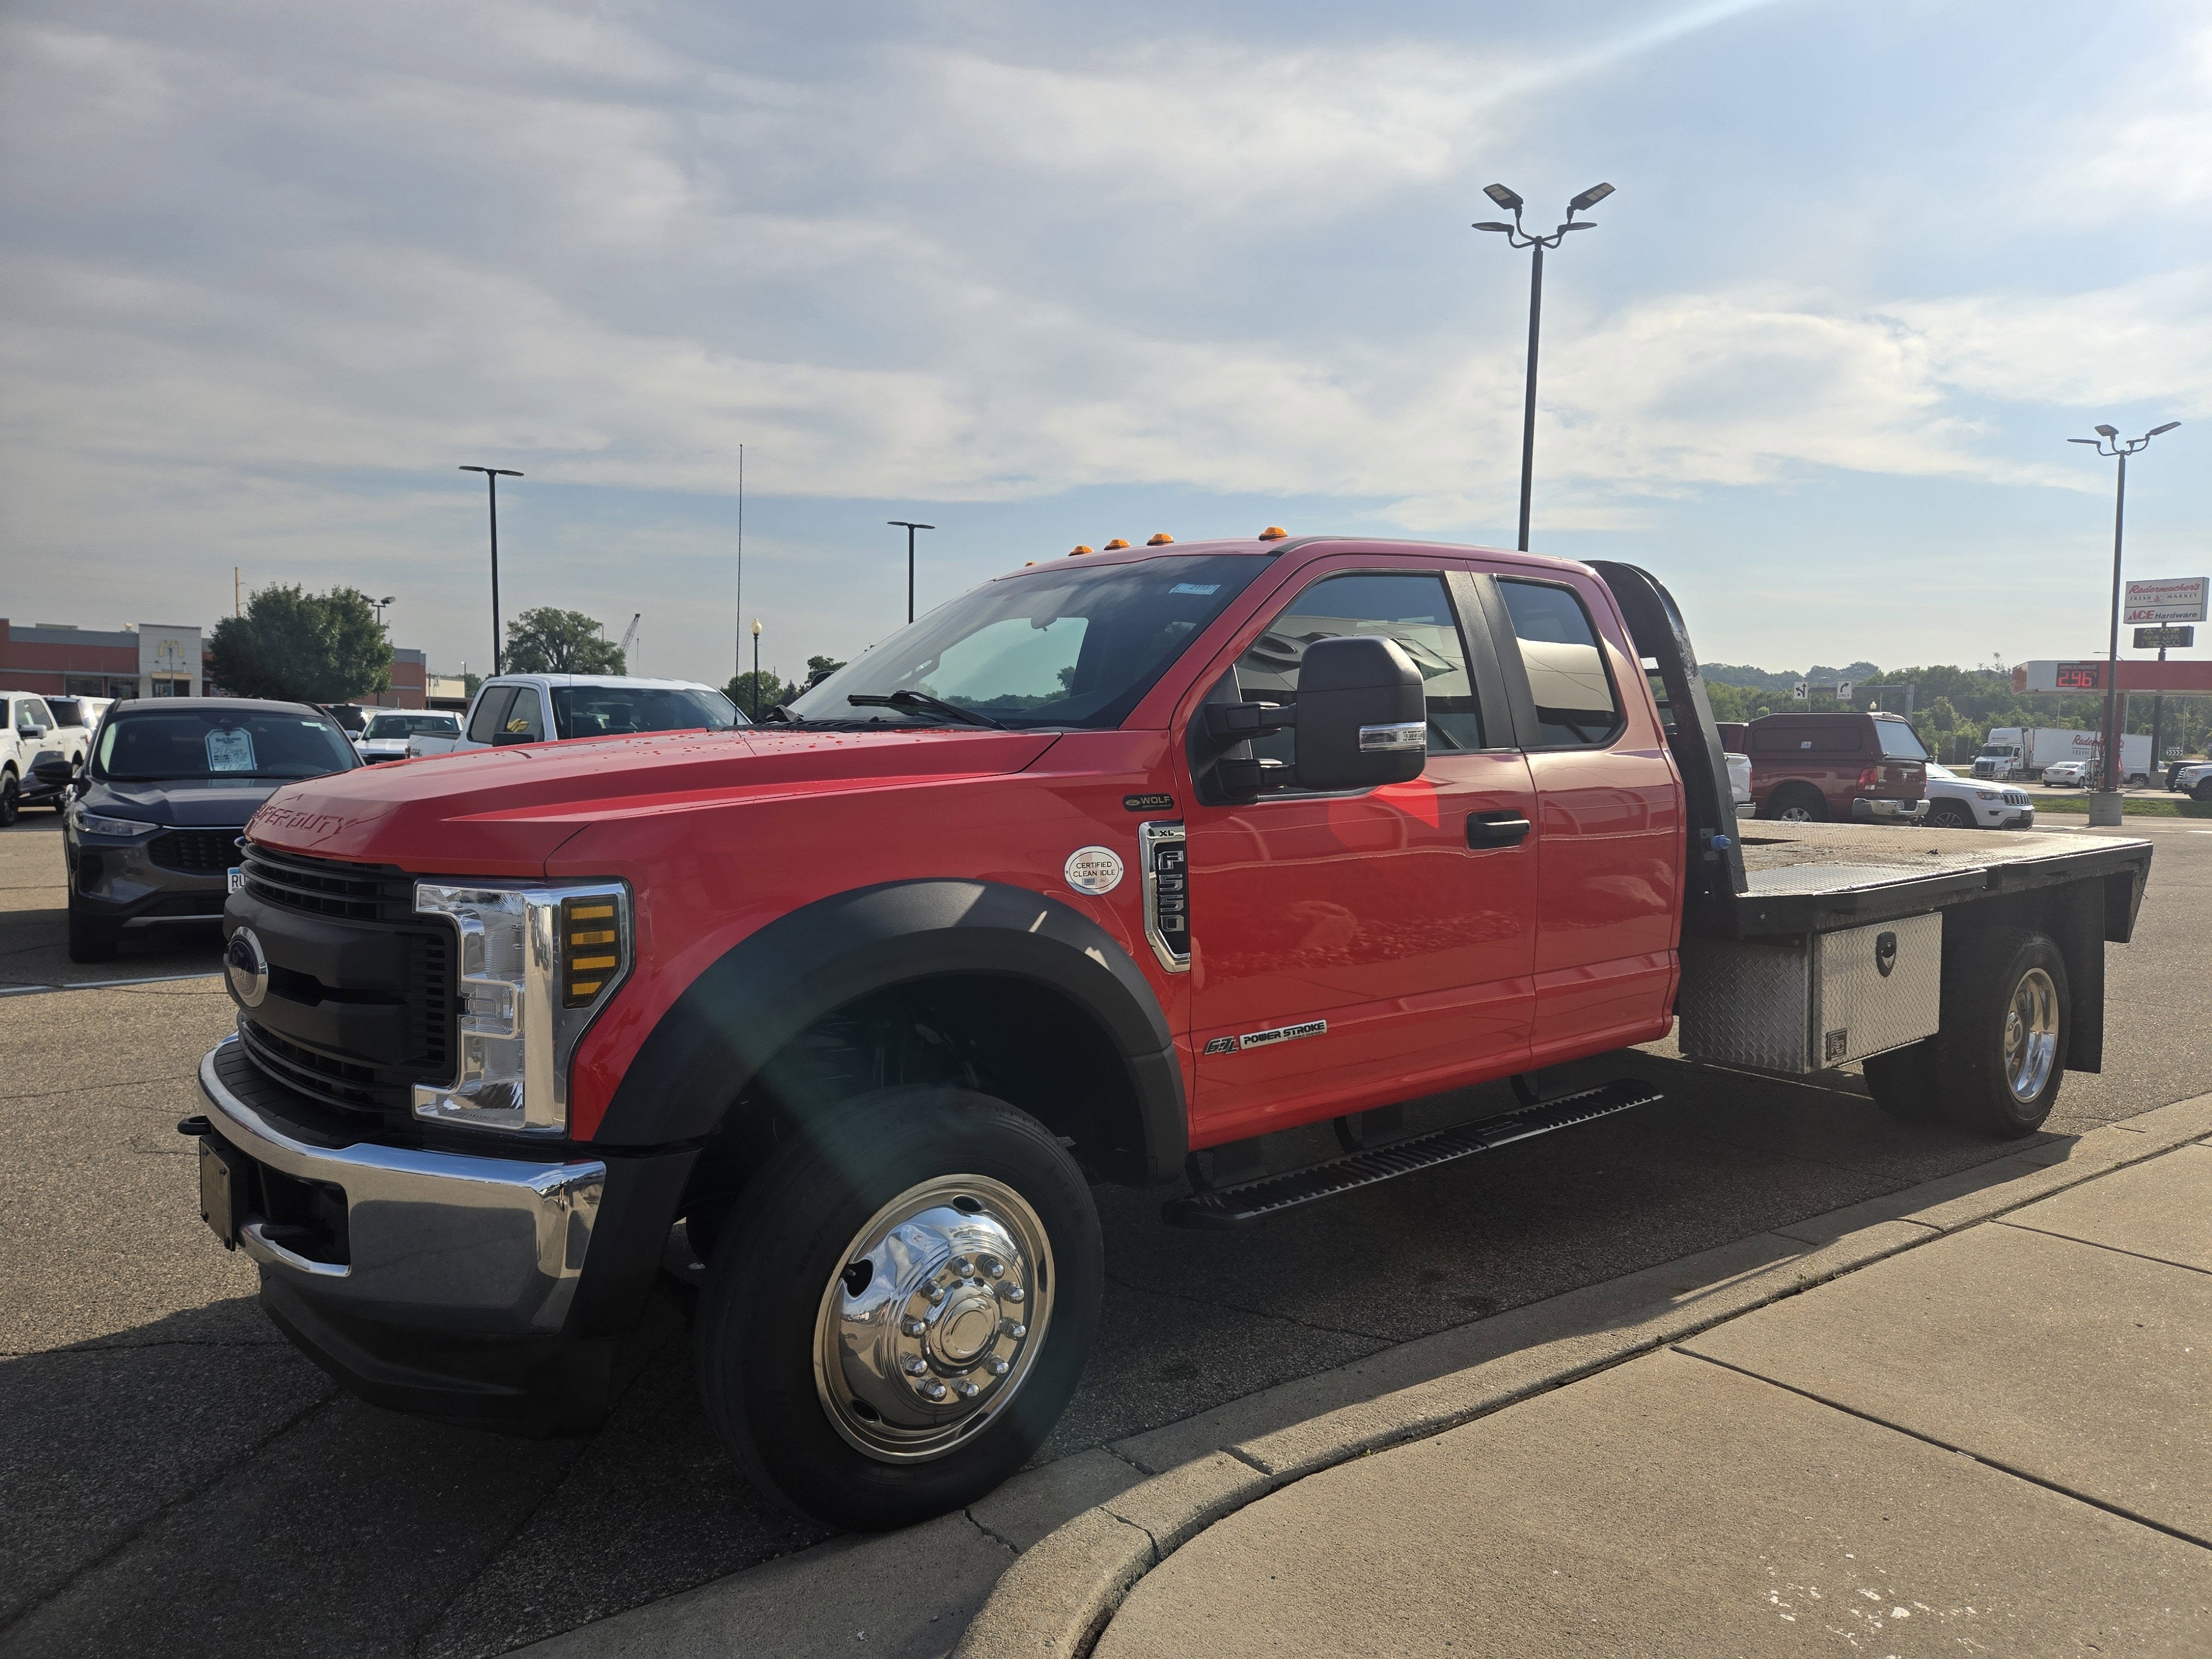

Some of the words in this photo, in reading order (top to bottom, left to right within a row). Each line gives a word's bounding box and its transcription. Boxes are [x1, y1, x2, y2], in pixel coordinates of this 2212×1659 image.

[2128, 583, 2200, 594] Radermacher's
[2127, 609, 2155, 620] ACE
[1140, 796, 1171, 804] WOLF
[1243, 1030, 1281, 1045] POWER
[1284, 1021, 1325, 1037] STROKE
